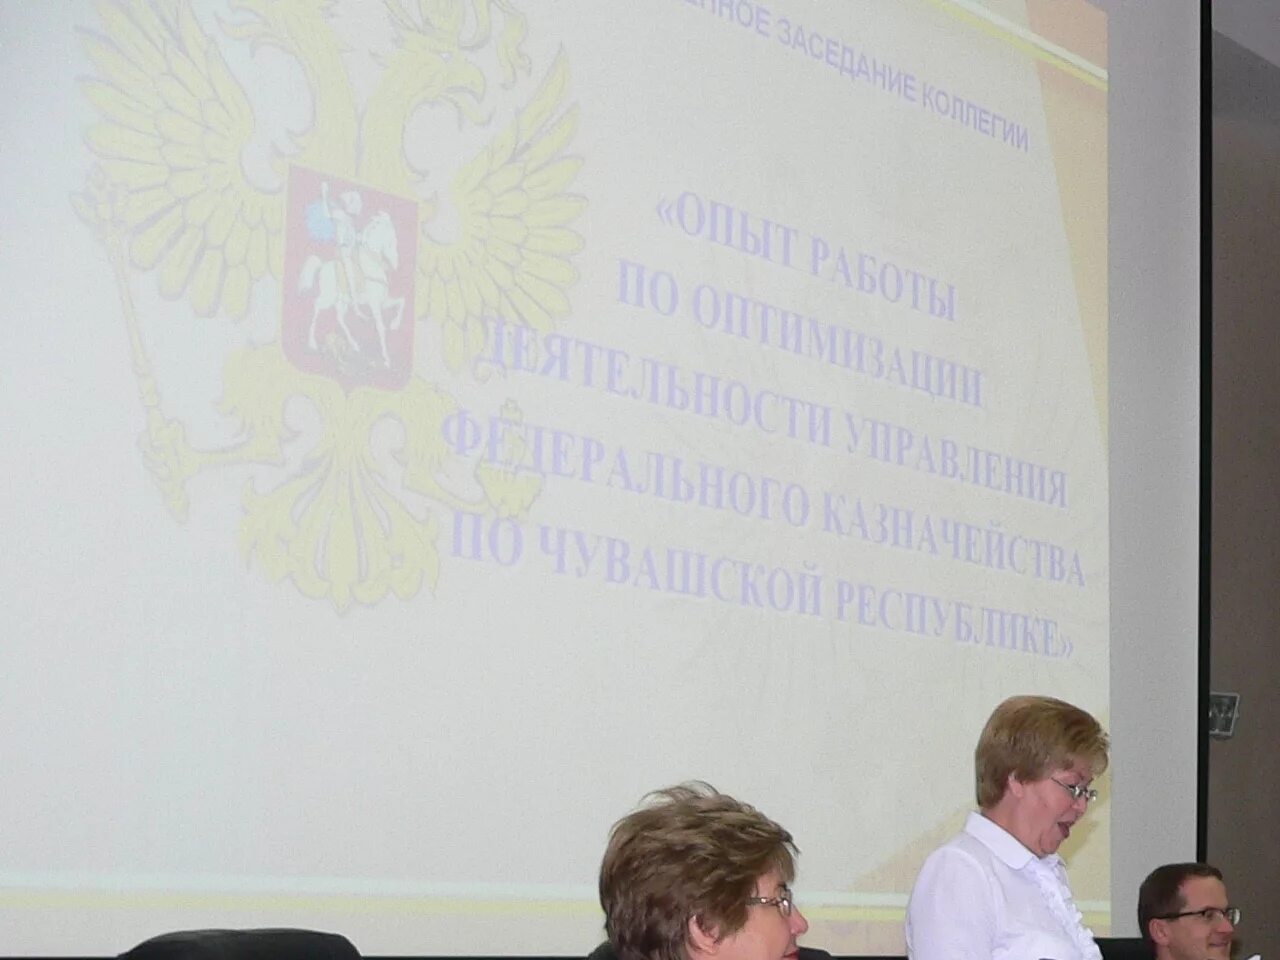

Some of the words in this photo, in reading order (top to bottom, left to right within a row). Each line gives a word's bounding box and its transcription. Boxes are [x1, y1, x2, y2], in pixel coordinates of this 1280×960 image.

[776, 16, 916, 101] ЗАСЕДАНИЕ
[921, 82, 1030, 153] КОЛЛЕГИИ
[655, 190, 799, 268] «ОПЫТ
[810, 233, 956, 322] РАБОТЫ
[617, 257, 679, 317] ПО
[691, 284, 984, 408] ОПТИМИЗАЦИИ
[478, 314, 833, 448] ДЕЯТЕЛЬНОСТИ
[844, 412, 1068, 509] УПРАВЛЕНИЯ
[441, 408, 810, 529] ФЕДЕРАЛЬНОГО
[821, 491, 1086, 588] КАЗНАЧЕЙСТВА
[450, 510, 524, 567] ПО
[538, 525, 822, 618] ЧУВАШСКОЙ
[835, 579, 1074, 660] РЕСПУБЛИКЕ»
